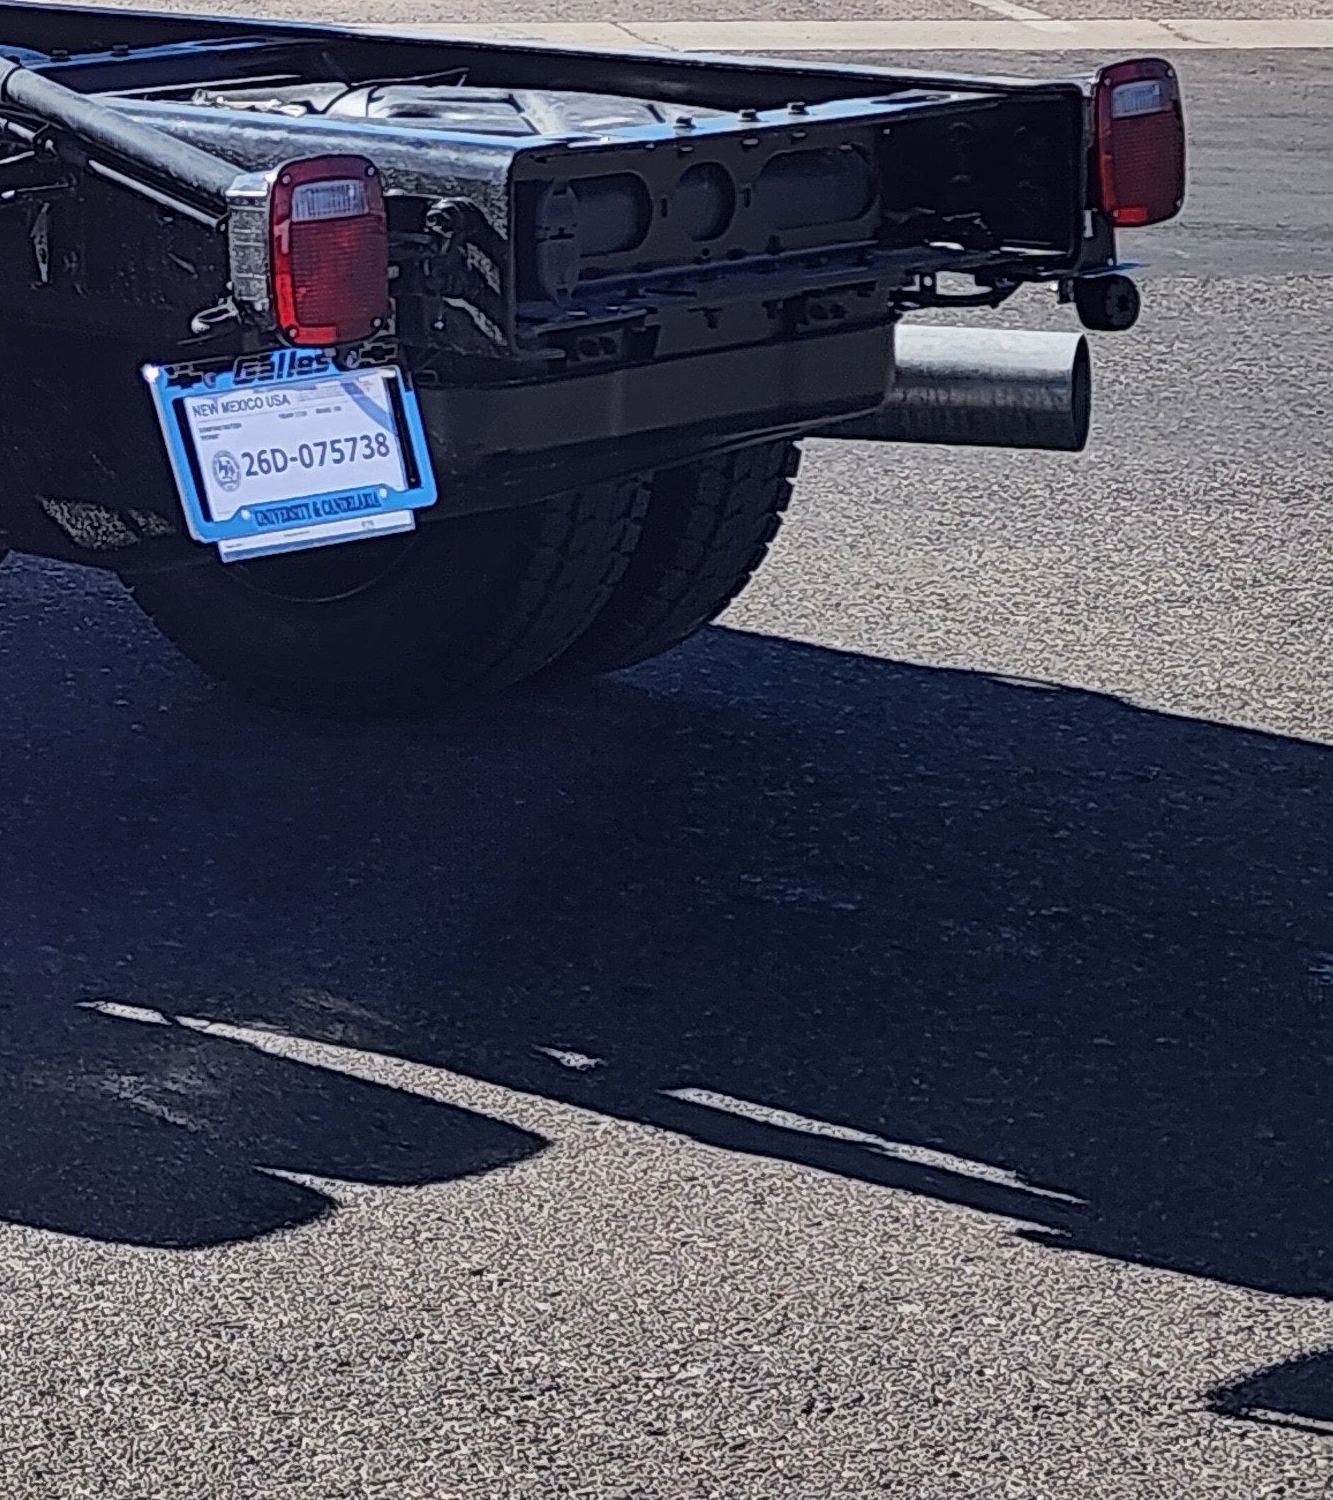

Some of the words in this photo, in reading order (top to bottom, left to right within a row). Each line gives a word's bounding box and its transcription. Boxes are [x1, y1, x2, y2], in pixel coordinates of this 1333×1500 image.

[192, 403, 220, 417] NEW
[221, 396, 264, 414] MEXICO
[266, 393, 290, 408] USA
[241, 432, 391, 478] 26D-075738
